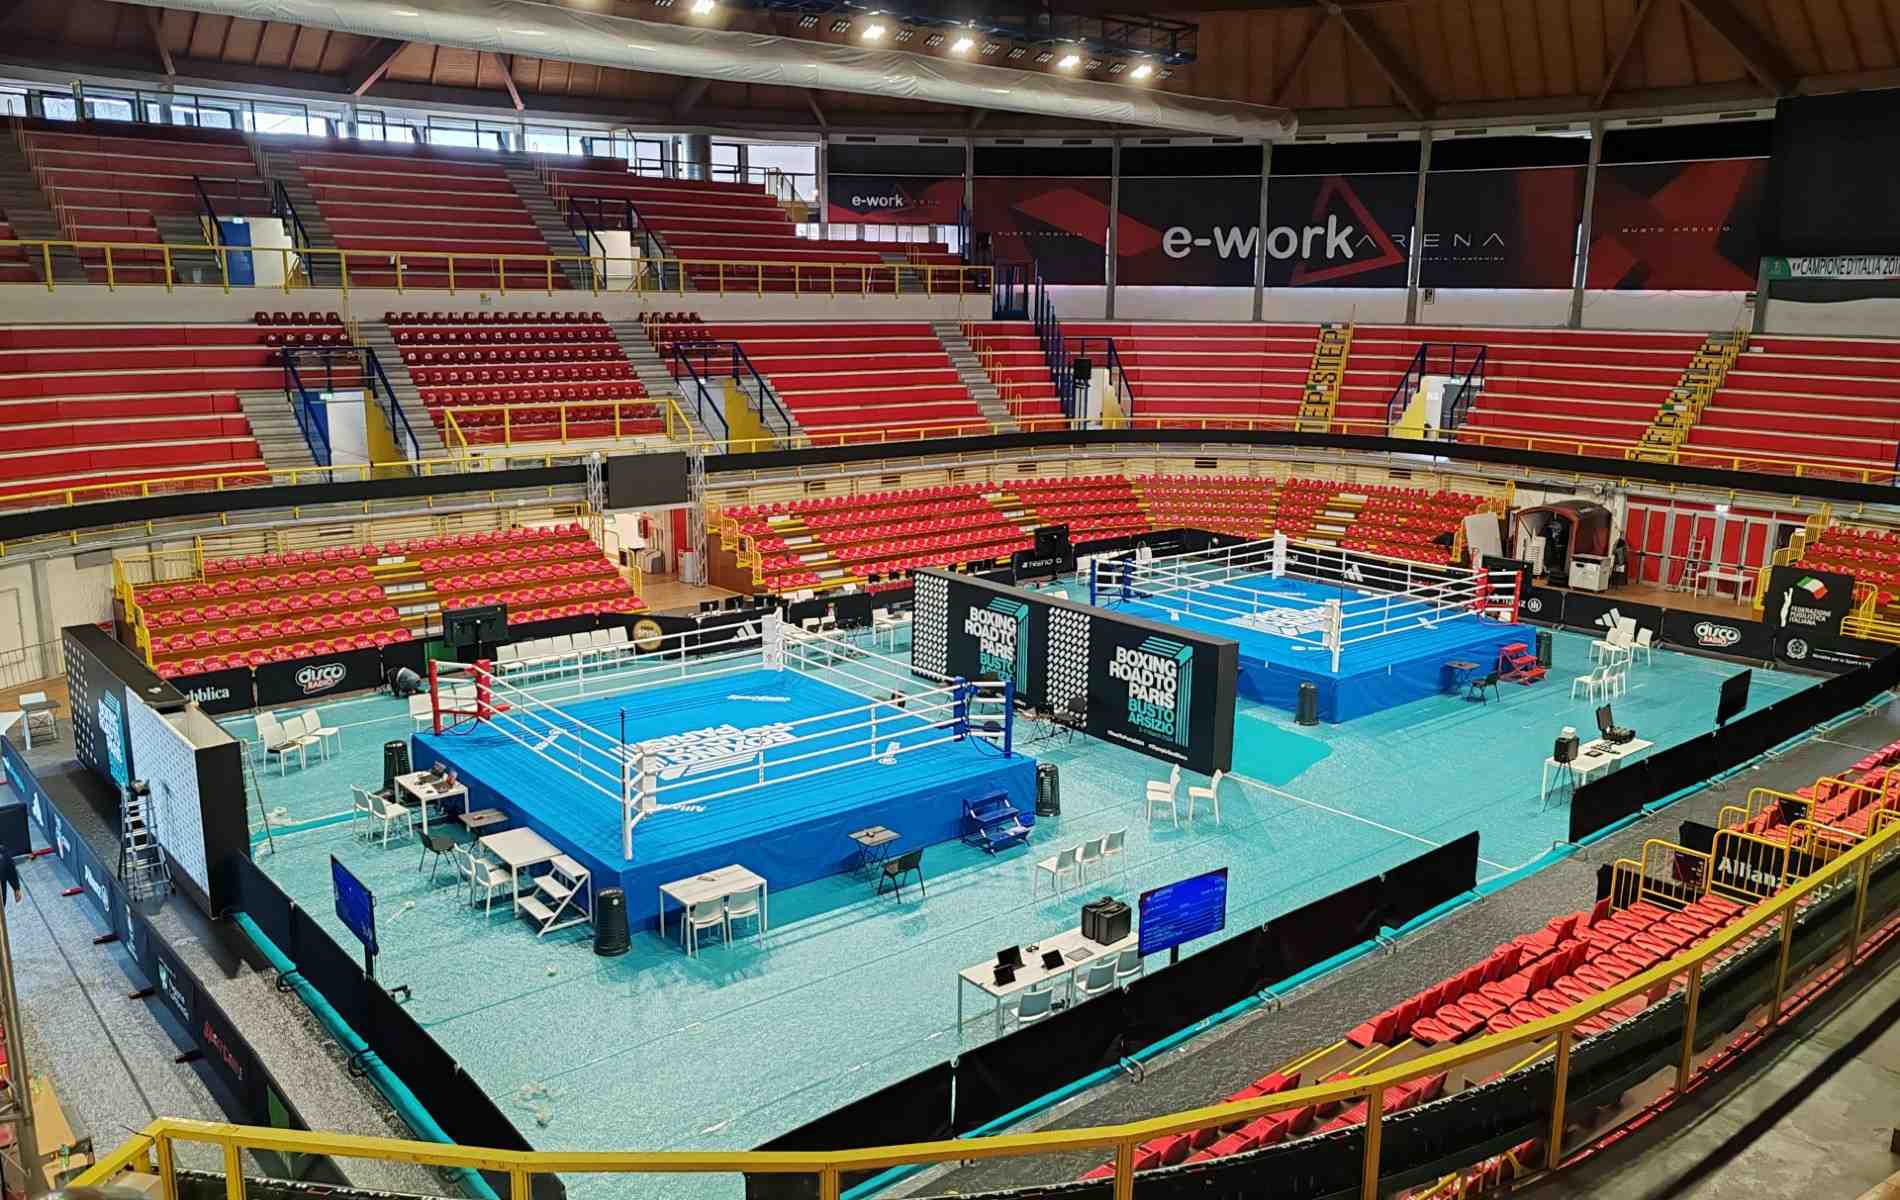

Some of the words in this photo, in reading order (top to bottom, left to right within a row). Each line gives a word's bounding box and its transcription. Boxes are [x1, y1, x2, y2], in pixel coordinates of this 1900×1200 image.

[852, 193, 903, 207] e-work
[1162, 214, 1354, 259] e-work
[965, 619, 1000, 642] ROAD
[970, 606, 1017, 632] BOXING
[980, 638, 1015, 664] PARIS
[1116, 646, 1177, 678] BOXING
[298, 664, 343, 684] disco
[1109, 660, 1154, 687] ROAD
[1154, 672, 1177, 693] TO
[1129, 681, 1175, 710] PARIS
[1128, 699, 1175, 723] BUSTO
[1128, 711, 1174, 735] ARSIZIO
[1718, 856, 1781, 888] Allian
